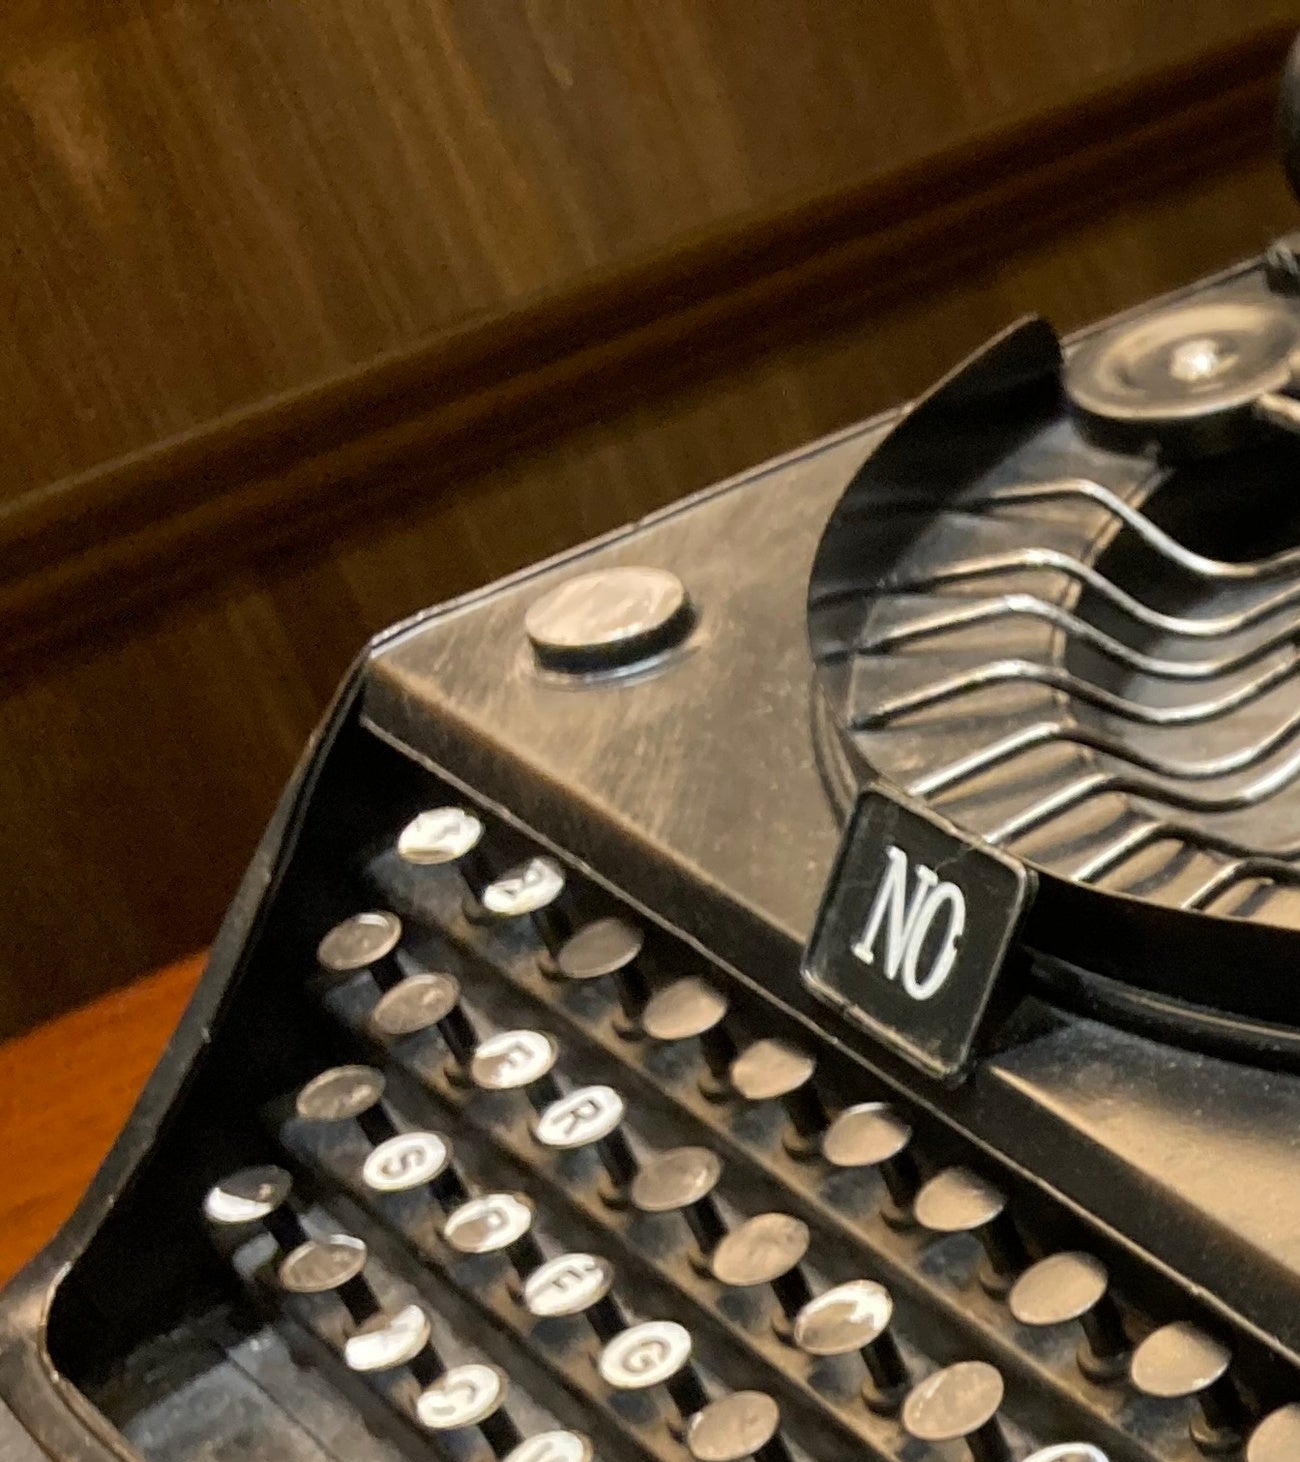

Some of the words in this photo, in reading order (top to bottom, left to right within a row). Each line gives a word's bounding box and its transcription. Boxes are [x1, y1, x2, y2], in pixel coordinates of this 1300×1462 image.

[851, 844, 966, 1000] NO
[552, 1098, 600, 1135] R
[380, 1144, 425, 1176] S
